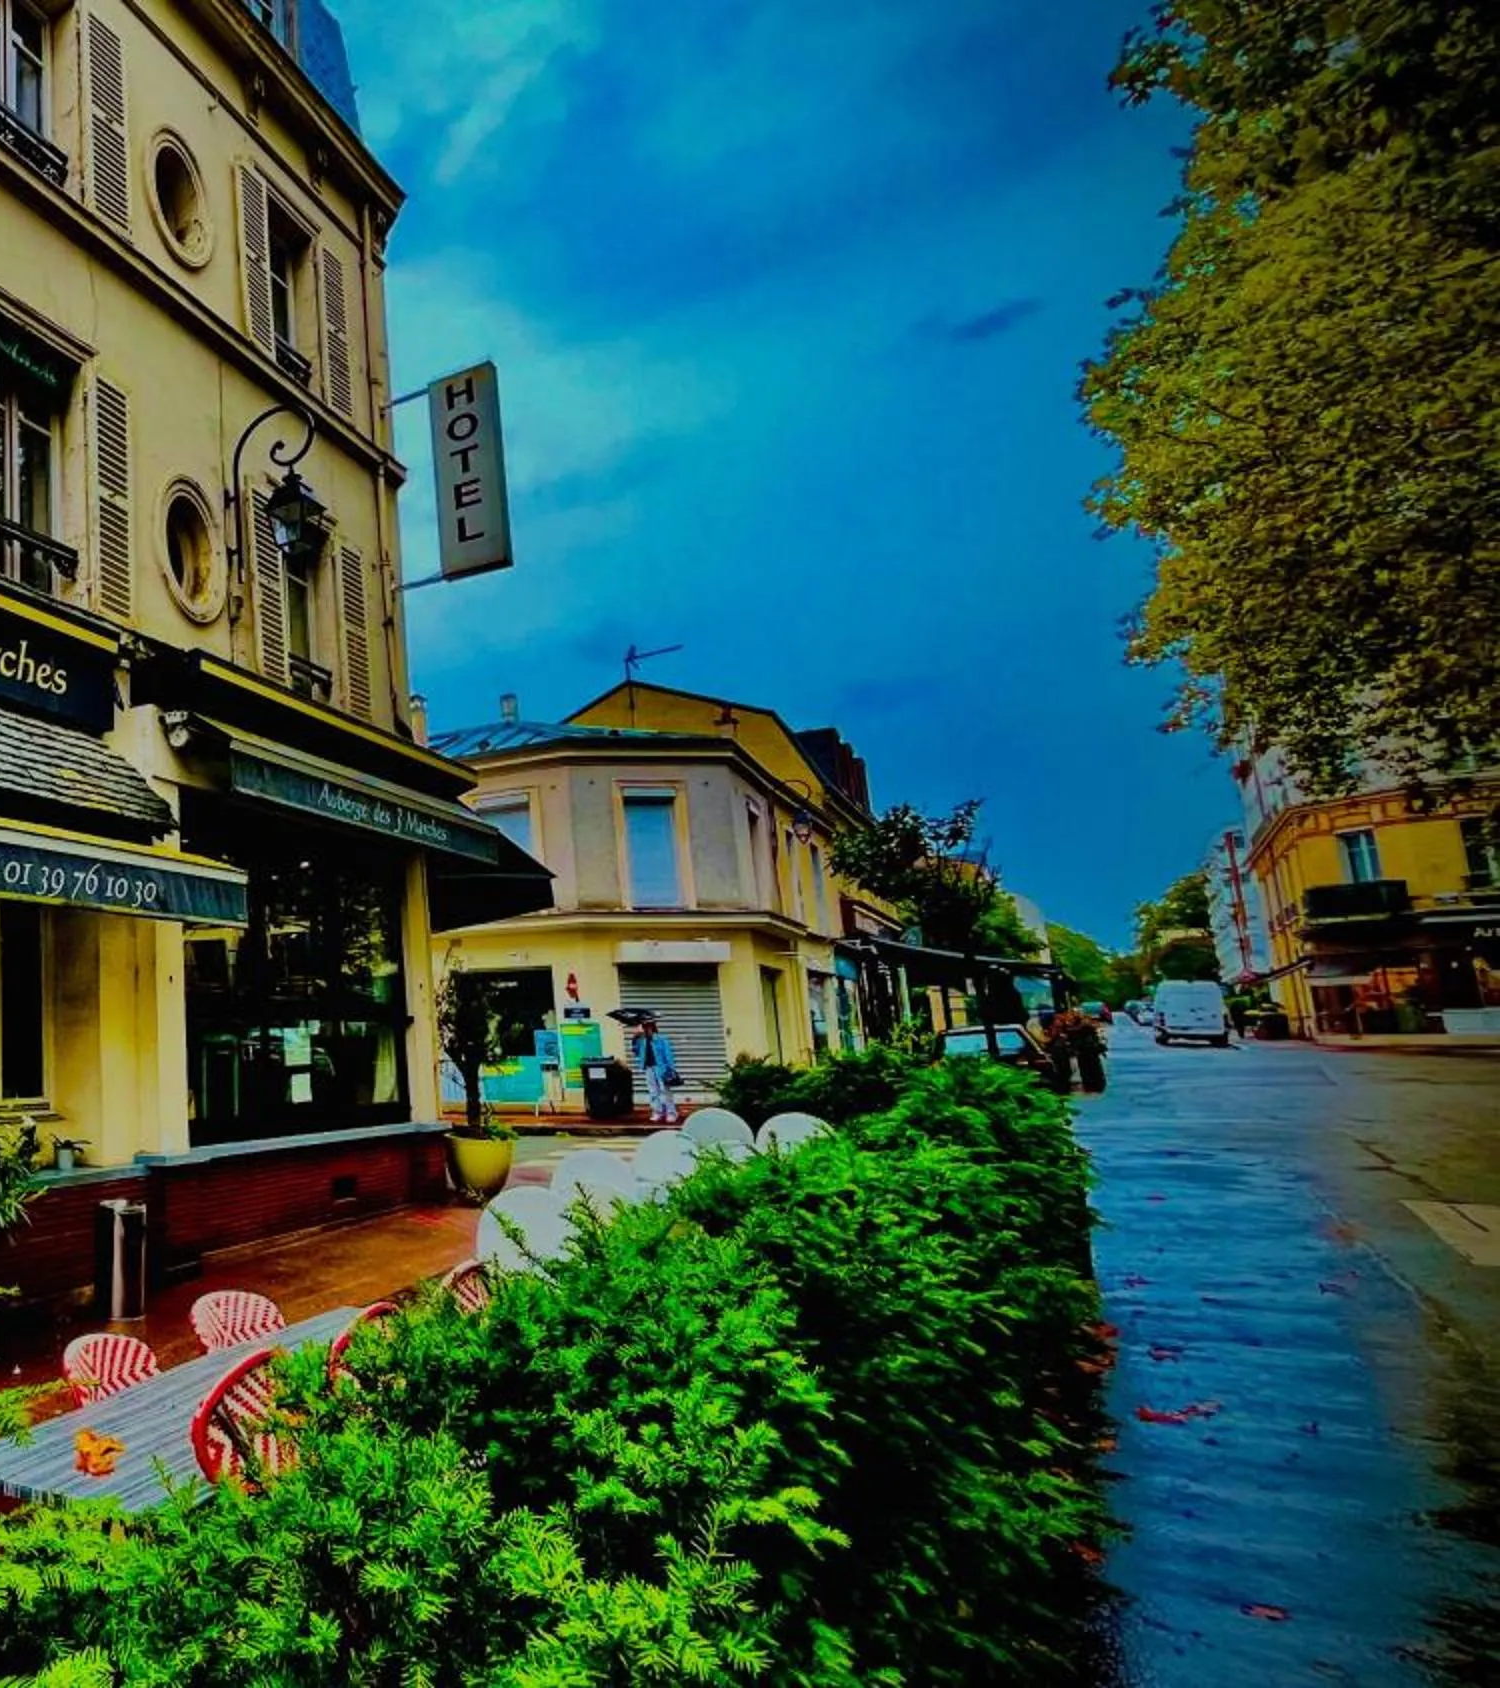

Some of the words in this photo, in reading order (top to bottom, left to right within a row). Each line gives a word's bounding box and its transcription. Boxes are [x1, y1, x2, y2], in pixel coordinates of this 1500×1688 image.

[445, 376, 485, 543] HOTEL
[318, 783, 368, 821] Auberge
[373, 802, 392, 825] des
[405, 811, 448, 841] Marches
[4, 861, 32, 885] 01
[36, 866, 65, 897] 39
[70, 863, 100, 901] 76
[106, 876, 128, 899] 10
[131, 881, 157, 907] 30
